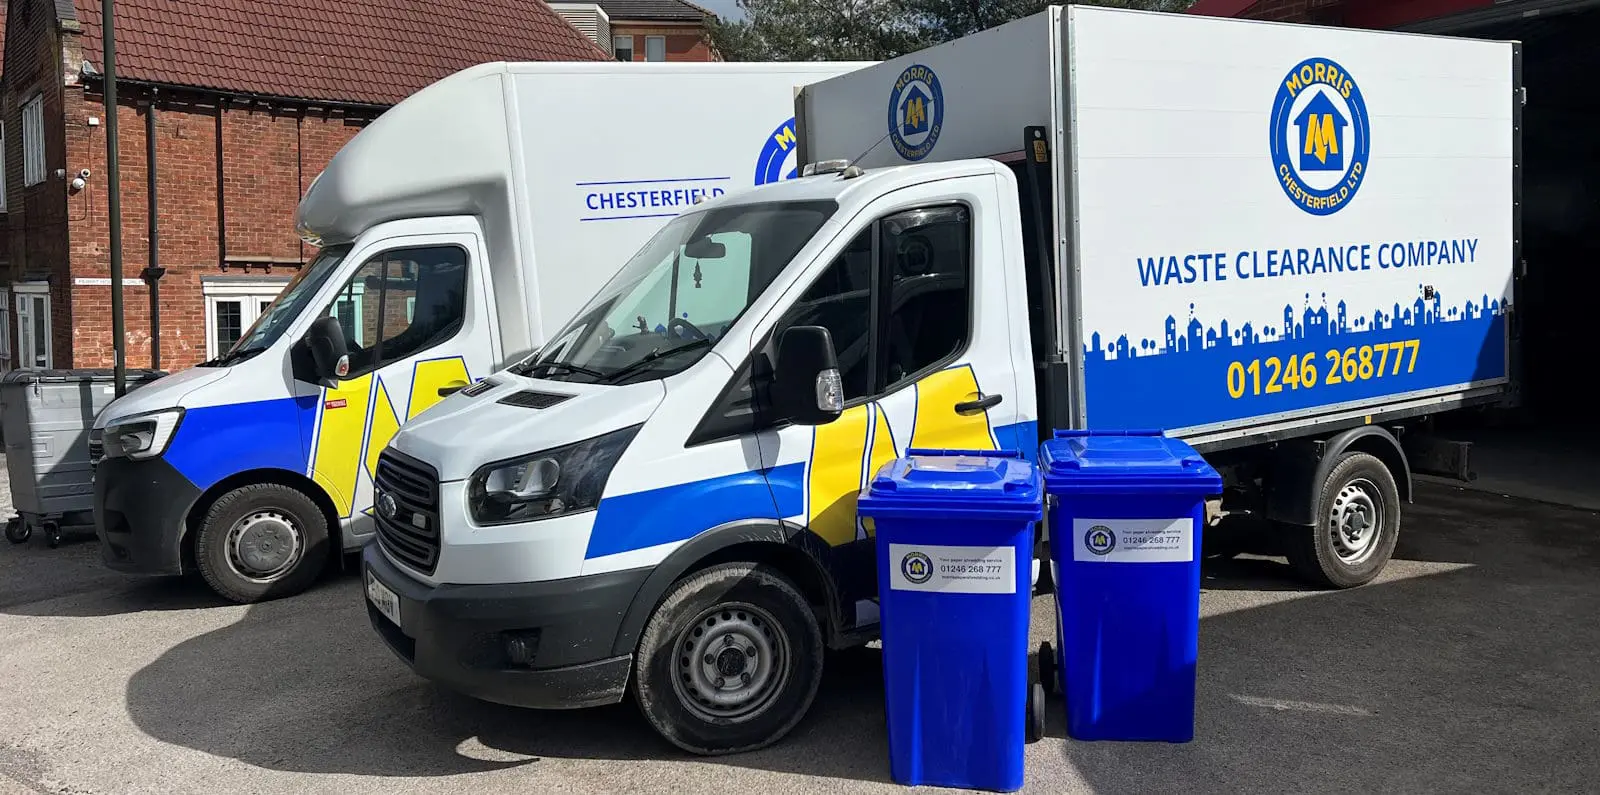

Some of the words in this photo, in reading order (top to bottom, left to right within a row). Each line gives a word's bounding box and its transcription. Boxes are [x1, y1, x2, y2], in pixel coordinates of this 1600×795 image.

[896, 67, 933, 93] MORRIS
[1286, 63, 1353, 98] MORRIS
[1279, 164, 1349, 209] CHESTERFIELD
[1350, 161, 1363, 188] LTD
[1136, 253, 1227, 287] WASTE
[1235, 244, 1371, 279] CLEARANCE
[1377, 238, 1478, 269] COMPANY
[1227, 351, 1317, 399] 01246
[1325, 339, 1420, 385] 268777
[1123, 536, 1147, 544] 01246
[1149, 536, 1164, 544] 268
[1166, 536, 1180, 544] 777
[941, 565, 966, 573] 01246
[968, 565, 984, 573] 268
